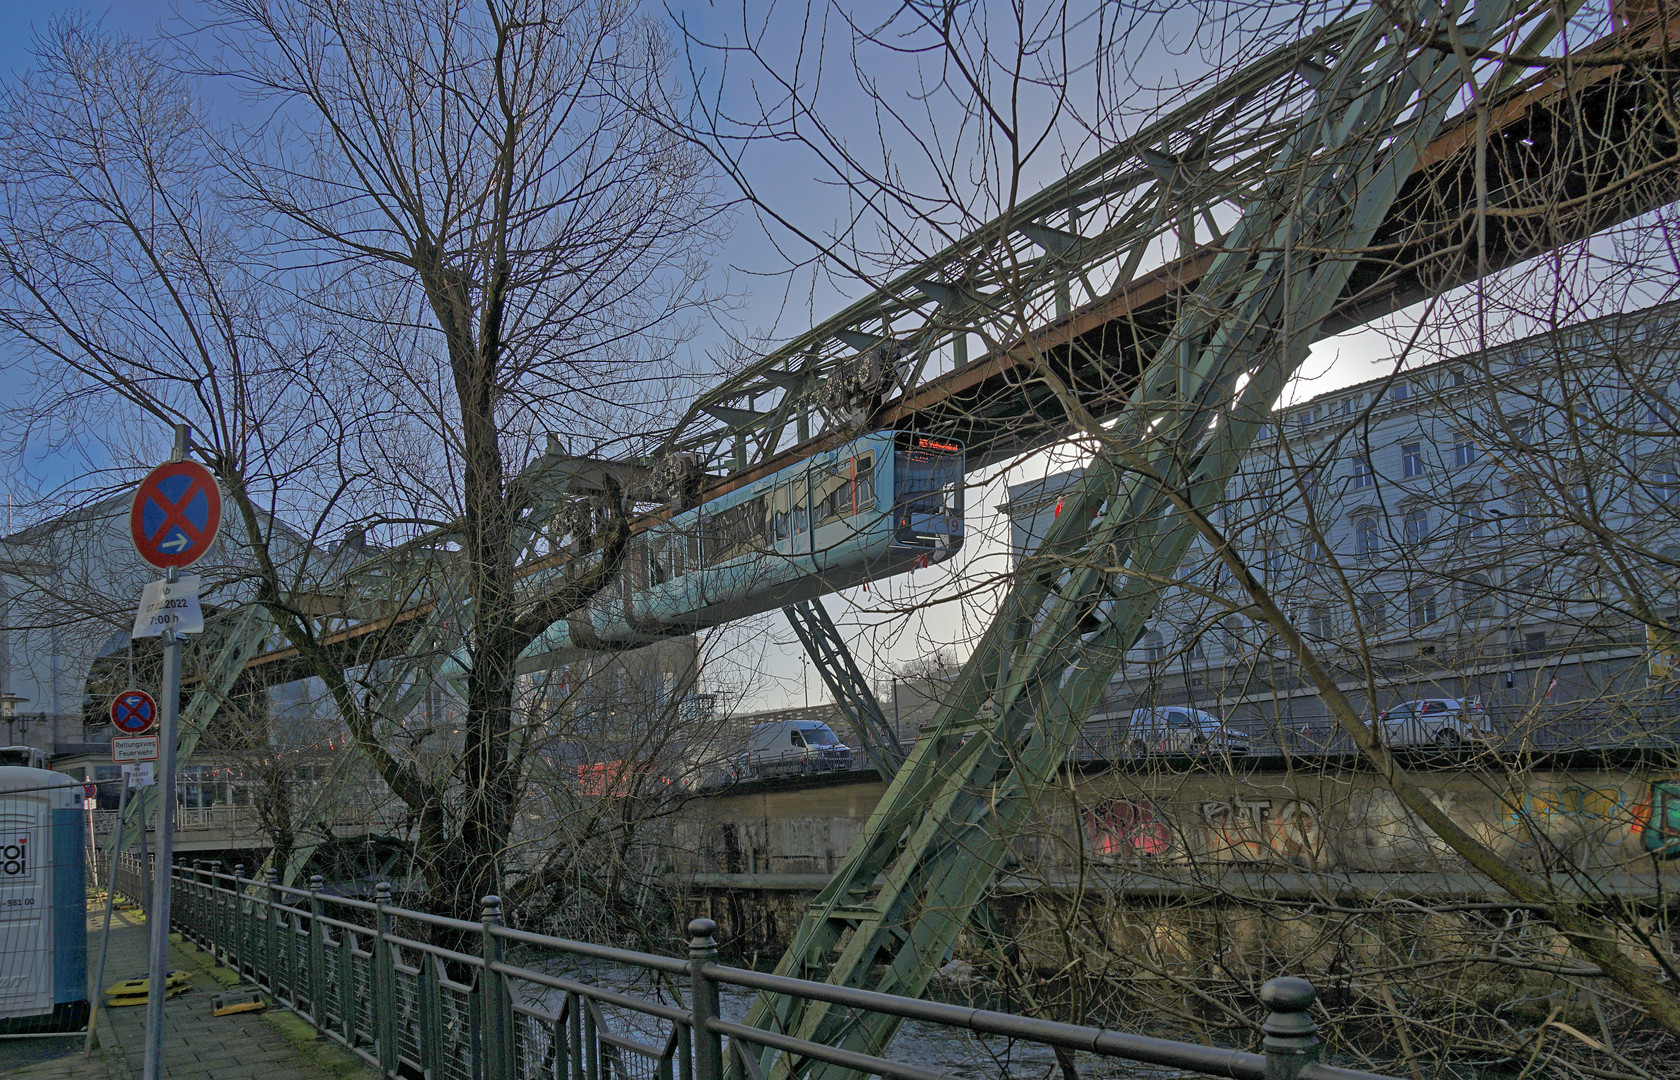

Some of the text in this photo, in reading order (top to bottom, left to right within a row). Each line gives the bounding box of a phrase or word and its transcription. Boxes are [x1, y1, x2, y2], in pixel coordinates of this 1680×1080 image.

[150, 614, 179, 625] 7:00 h
[24, 897, 35, 905] 00
